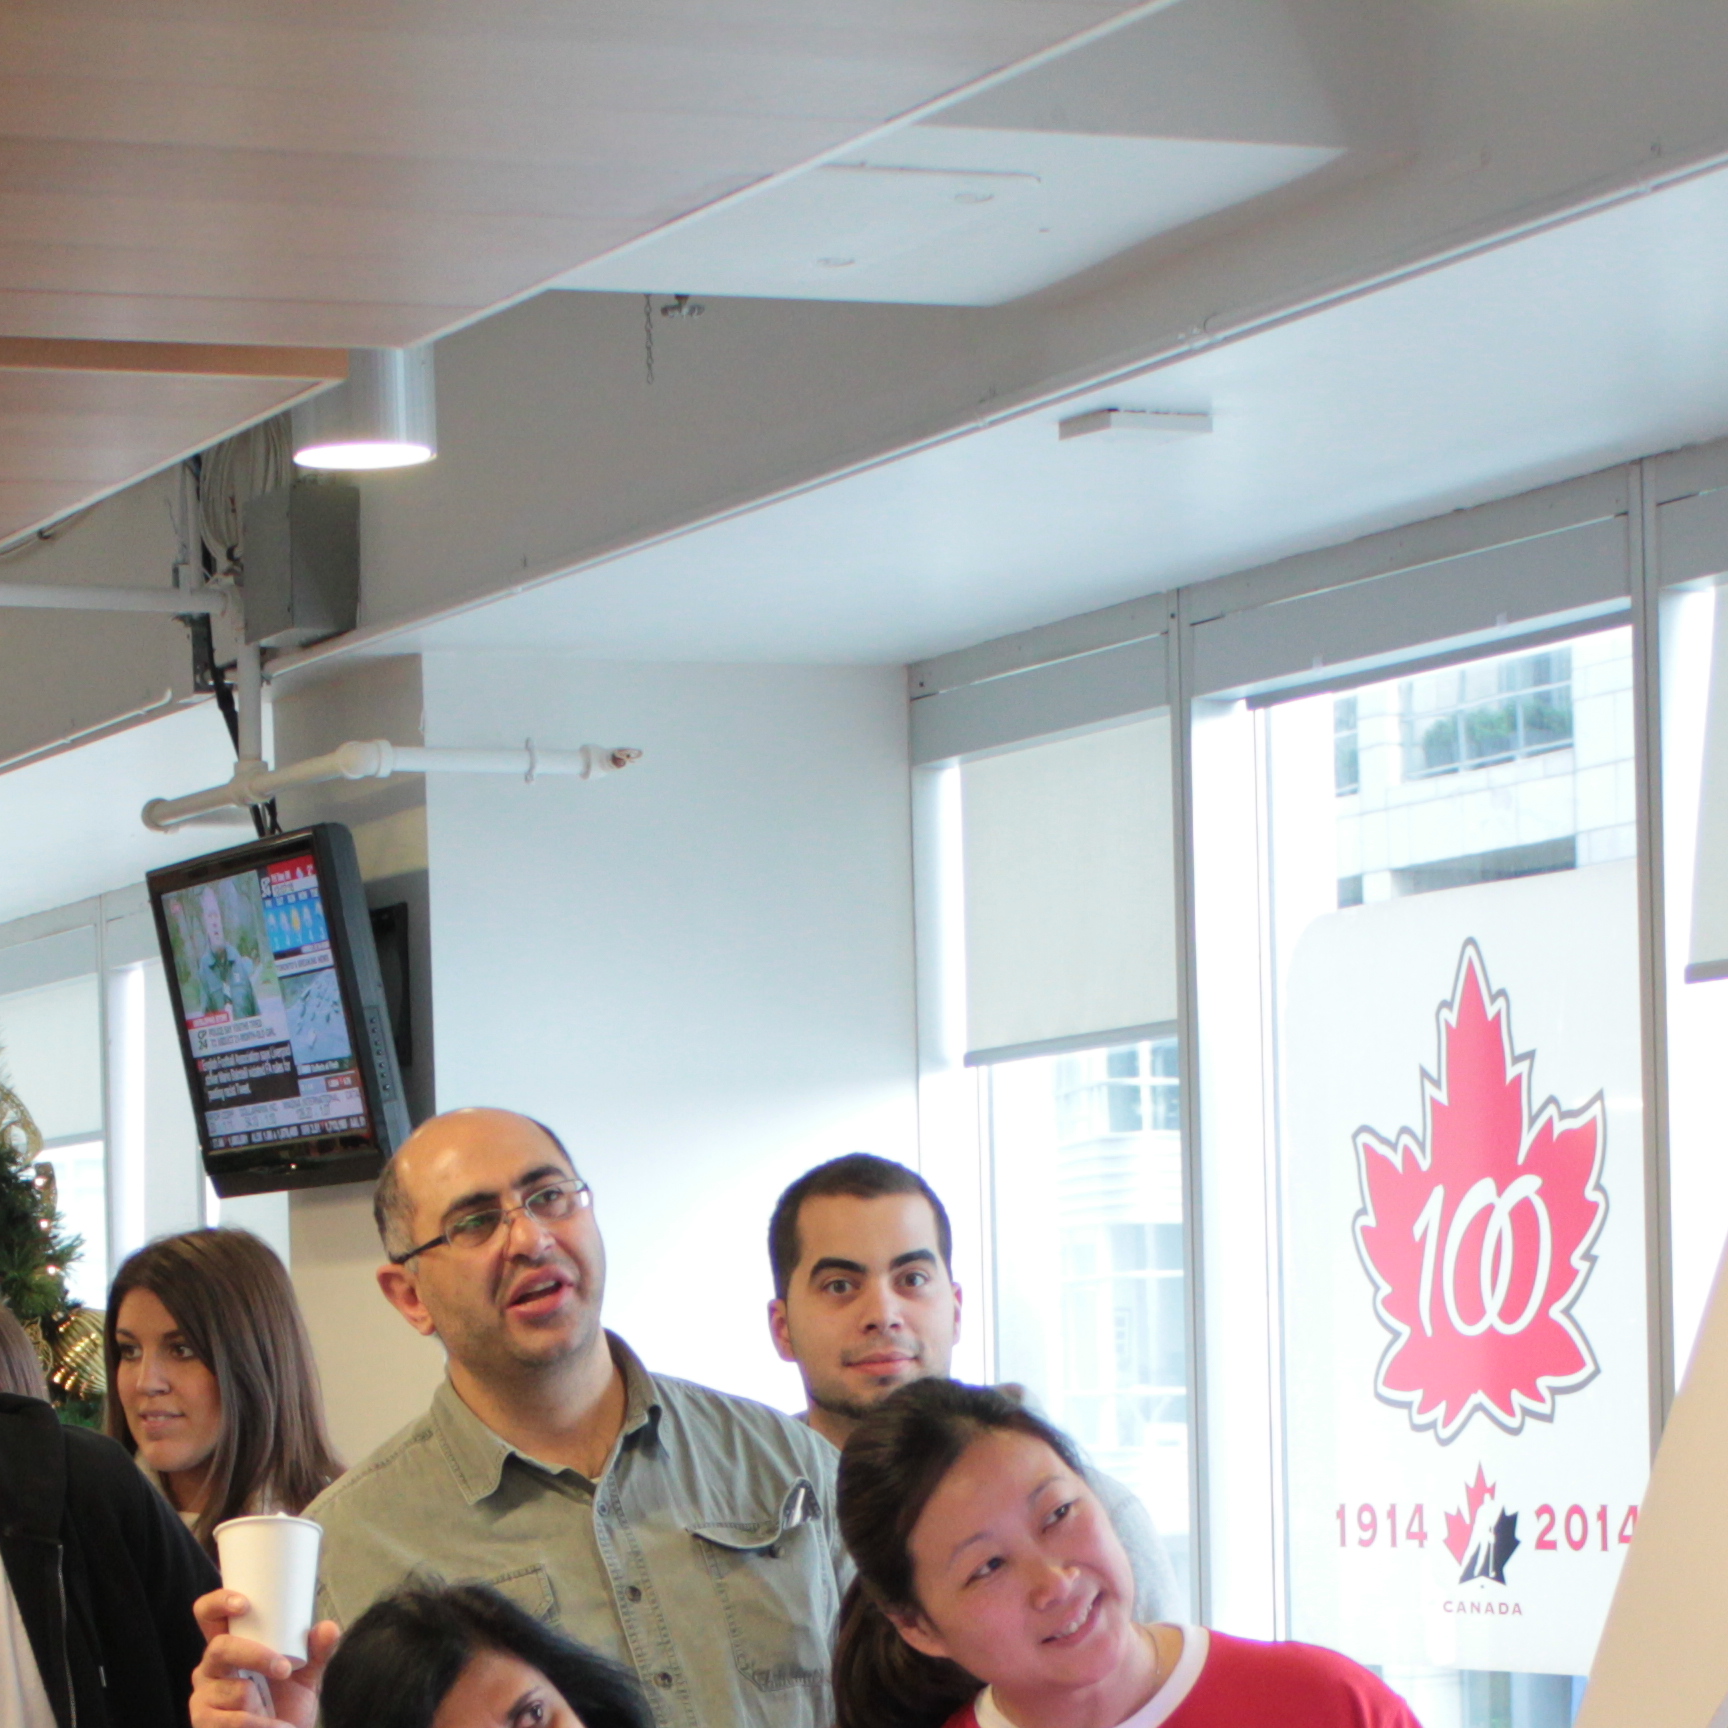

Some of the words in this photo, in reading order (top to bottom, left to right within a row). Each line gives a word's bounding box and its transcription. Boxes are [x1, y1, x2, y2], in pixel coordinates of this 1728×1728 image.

[1412, 1173, 1552, 1338] 100
[1336, 1502, 1428, 1549] 1914
[1443, 1600, 1523, 1616] CANADA
